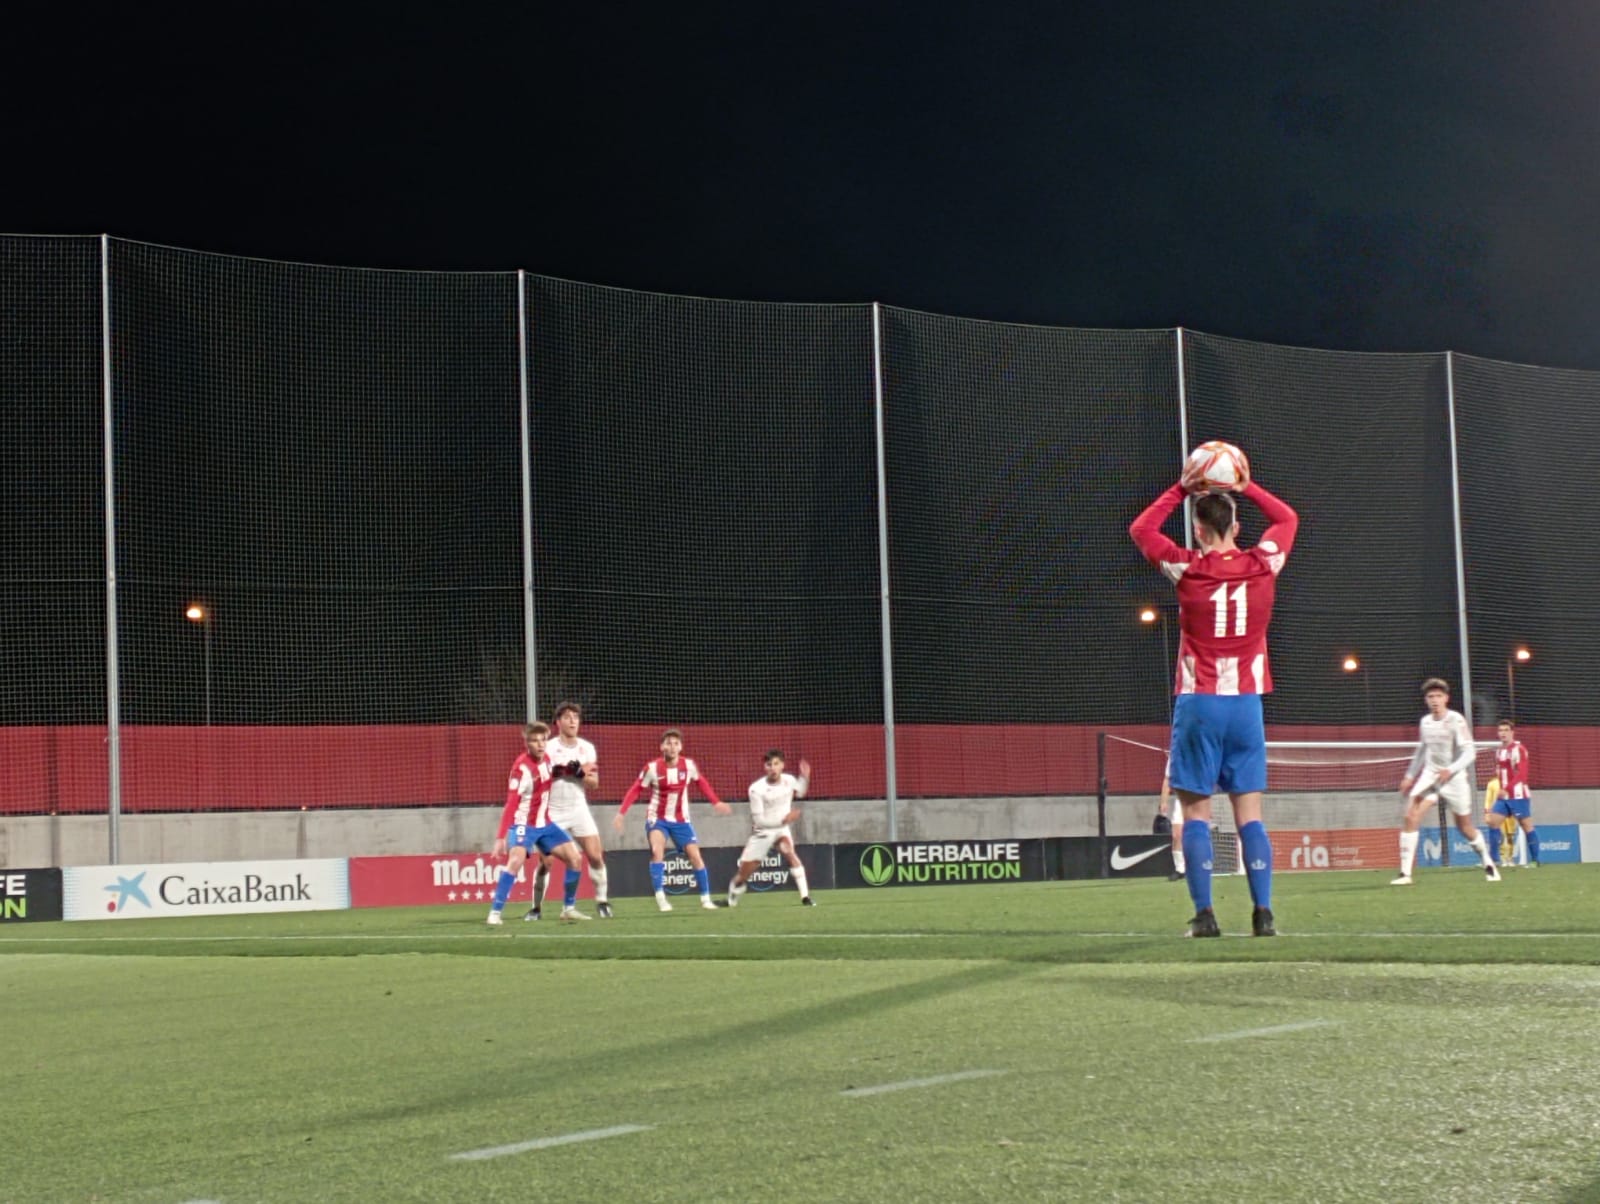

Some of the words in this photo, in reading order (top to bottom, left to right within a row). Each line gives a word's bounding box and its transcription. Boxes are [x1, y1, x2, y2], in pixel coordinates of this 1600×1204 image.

[1209, 581, 1247, 638] 11
[897, 843, 1019, 863] HERBALIFE
[1291, 834, 1329, 868] ria
[898, 862, 1021, 882] NUTRITION
[159, 873, 312, 906] CaixaBank
